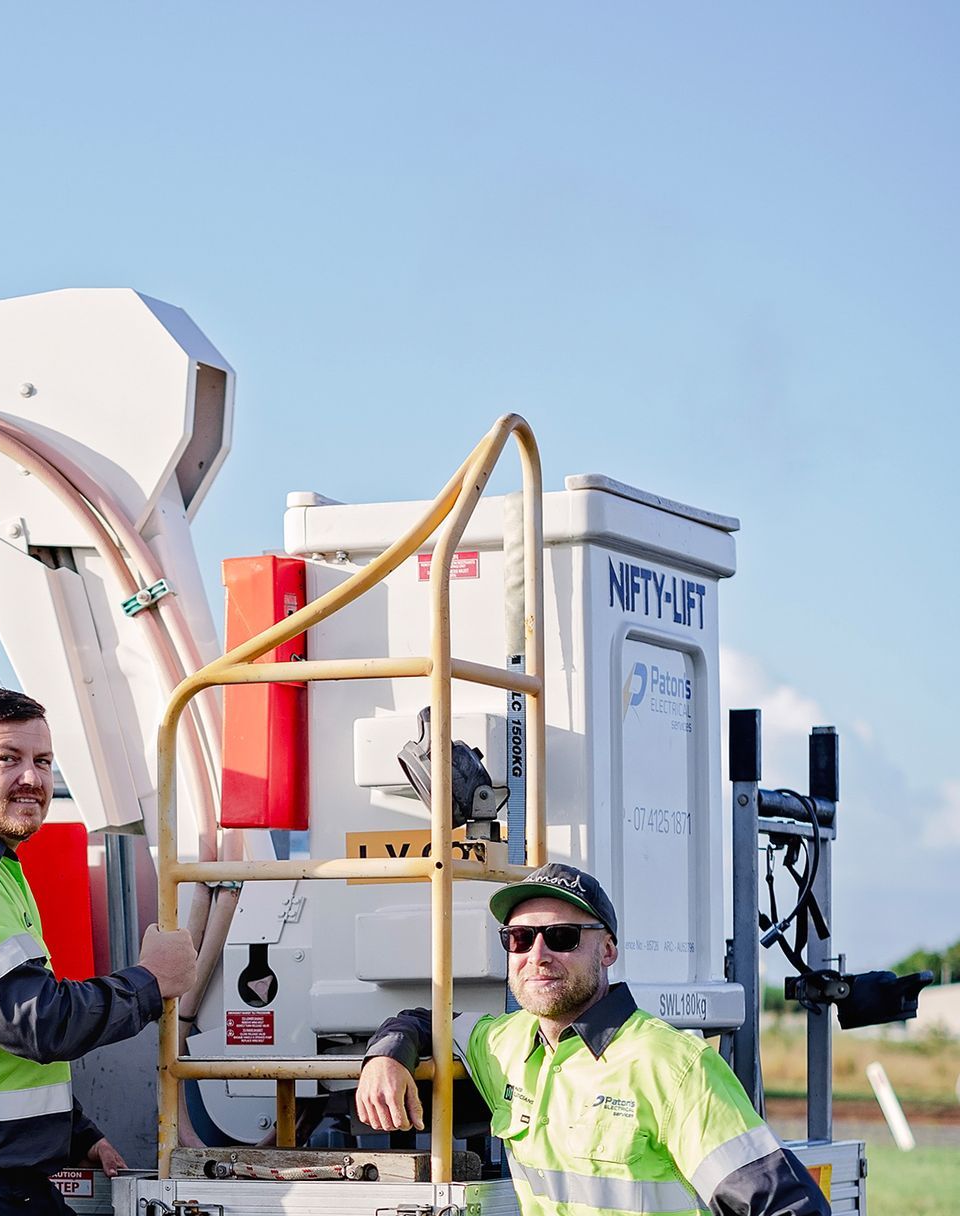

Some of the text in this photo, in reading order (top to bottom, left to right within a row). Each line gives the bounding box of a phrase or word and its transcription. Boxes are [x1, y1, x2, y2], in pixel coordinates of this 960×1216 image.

[608, 555, 706, 630] NIFTY-LIFT
[651, 665, 691, 700] Paton's
[651, 697, 691, 718] ELECTRICAL
[512, 719, 523, 778] 1500KG
[647, 809, 670, 833] 4125
[671, 811, 691, 835] 1871
[57, 1182, 80, 1193] TEP
